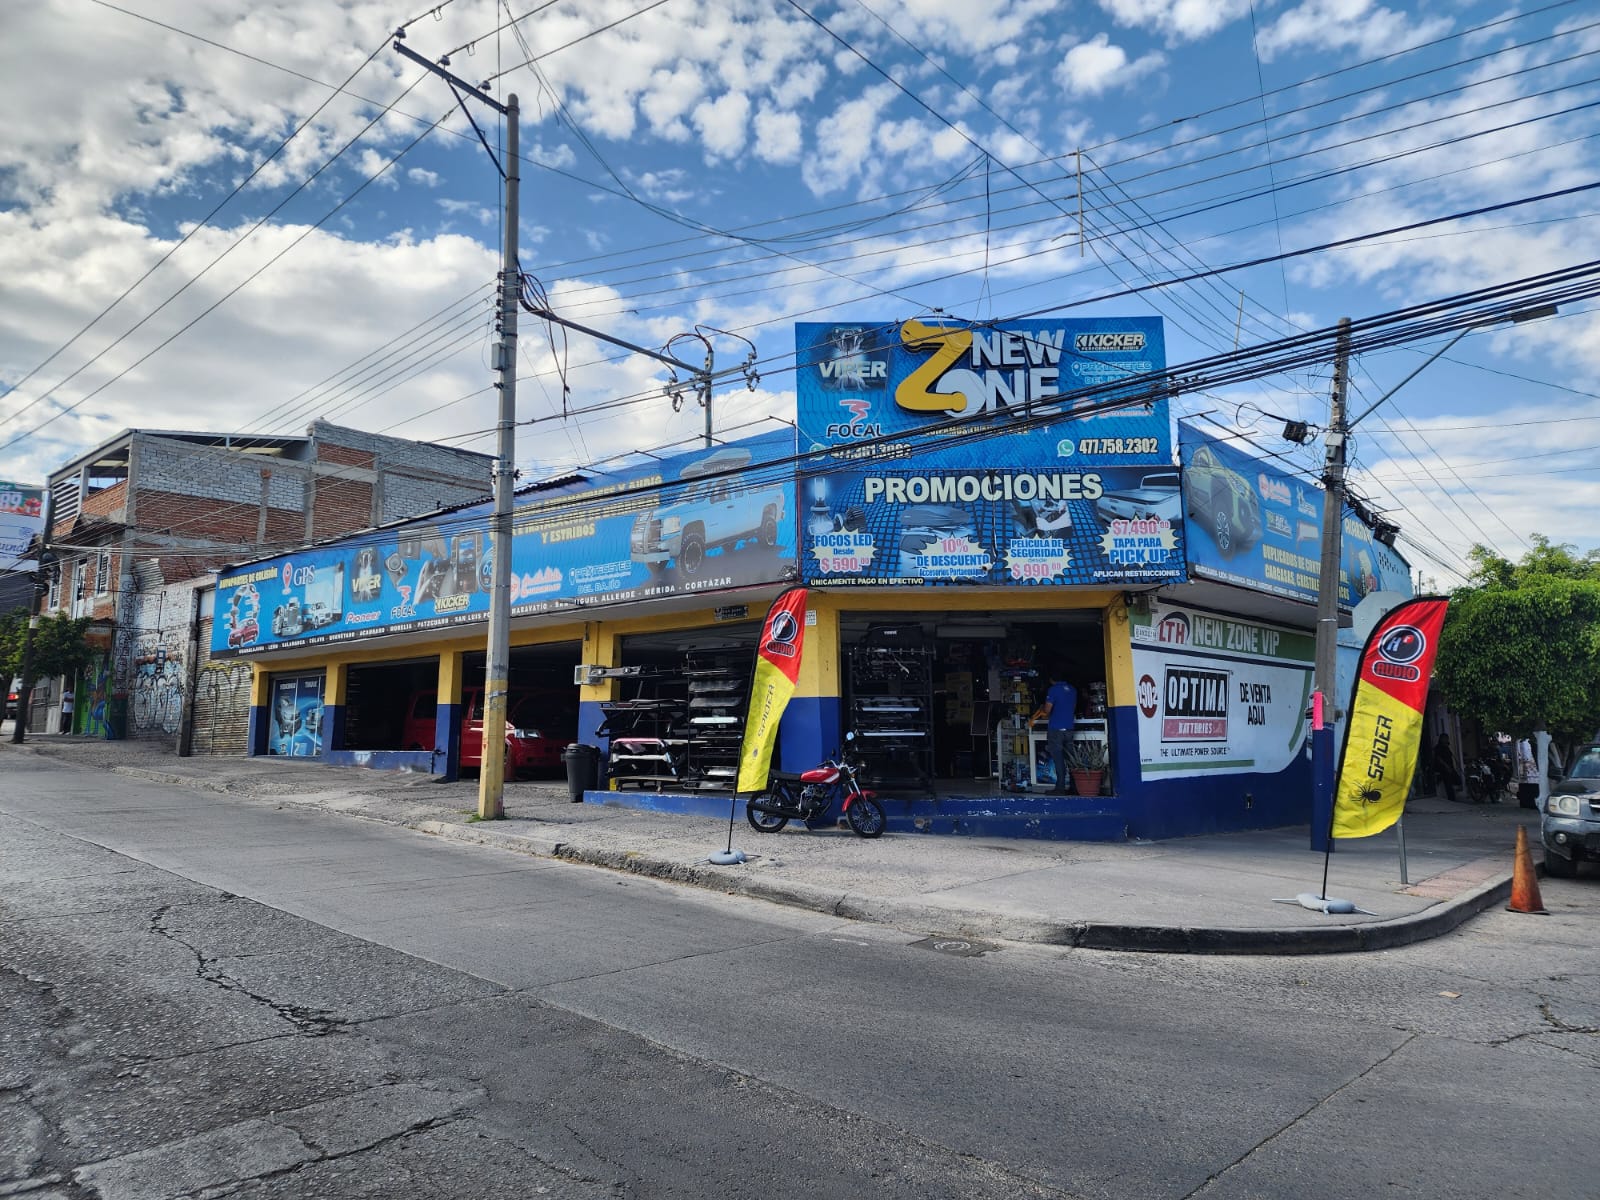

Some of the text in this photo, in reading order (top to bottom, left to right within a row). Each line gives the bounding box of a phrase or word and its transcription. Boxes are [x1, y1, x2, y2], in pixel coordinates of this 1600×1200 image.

[1088, 334, 1144, 347] KICKER
[972, 329, 1065, 367] NEW
[818, 360, 888, 378] VIPER
[826, 423, 885, 438] FOCAL
[1079, 438, 1158, 455] 477.758.2302
[865, 474, 1104, 503] PROMOCIONES
[815, 533, 873, 547] FOCOS LED
[942, 538, 969, 553] 10%
[1051, 539, 1063, 547] DE
[1113, 537, 1162, 548] TAPA PARA
[1010, 548, 1064, 558] SEGURIDAD
[1110, 549, 1169, 563] PICK UP
[916, 554, 990, 567] DE DESCUENTO
[293, 566, 315, 586] GPS
[1125, 569, 1180, 577] RESTRICCIONES
[857, 577, 877, 585] PAGO
[878, 577, 888, 585] EN
[889, 577, 925, 585] EFECTIVO
[442, 595, 469, 610] KICKER
[601, 590, 636, 601] ALLENDE
[346, 611, 381, 624] Pioneer
[391, 605, 417, 619] FOCAL
[467, 612, 482, 621] LUIS
[1159, 620, 1186, 645] LTH
[1195, 615, 1224, 647] NEW
[1227, 623, 1258, 653] ZONE
[1261, 629, 1280, 656] VIP
[1376, 662, 1417, 680] AUDIO
[1168, 675, 1226, 712] OPTIMA
[1239, 682, 1272, 704] DE VENTA
[1247, 705, 1266, 726] AQUI
[1178, 722, 1213, 735] BATTERIES
[1160, 746, 1227, 757] THE ULTIMATE POWER SOURCE
[1367, 714, 1393, 782] SPIDER
